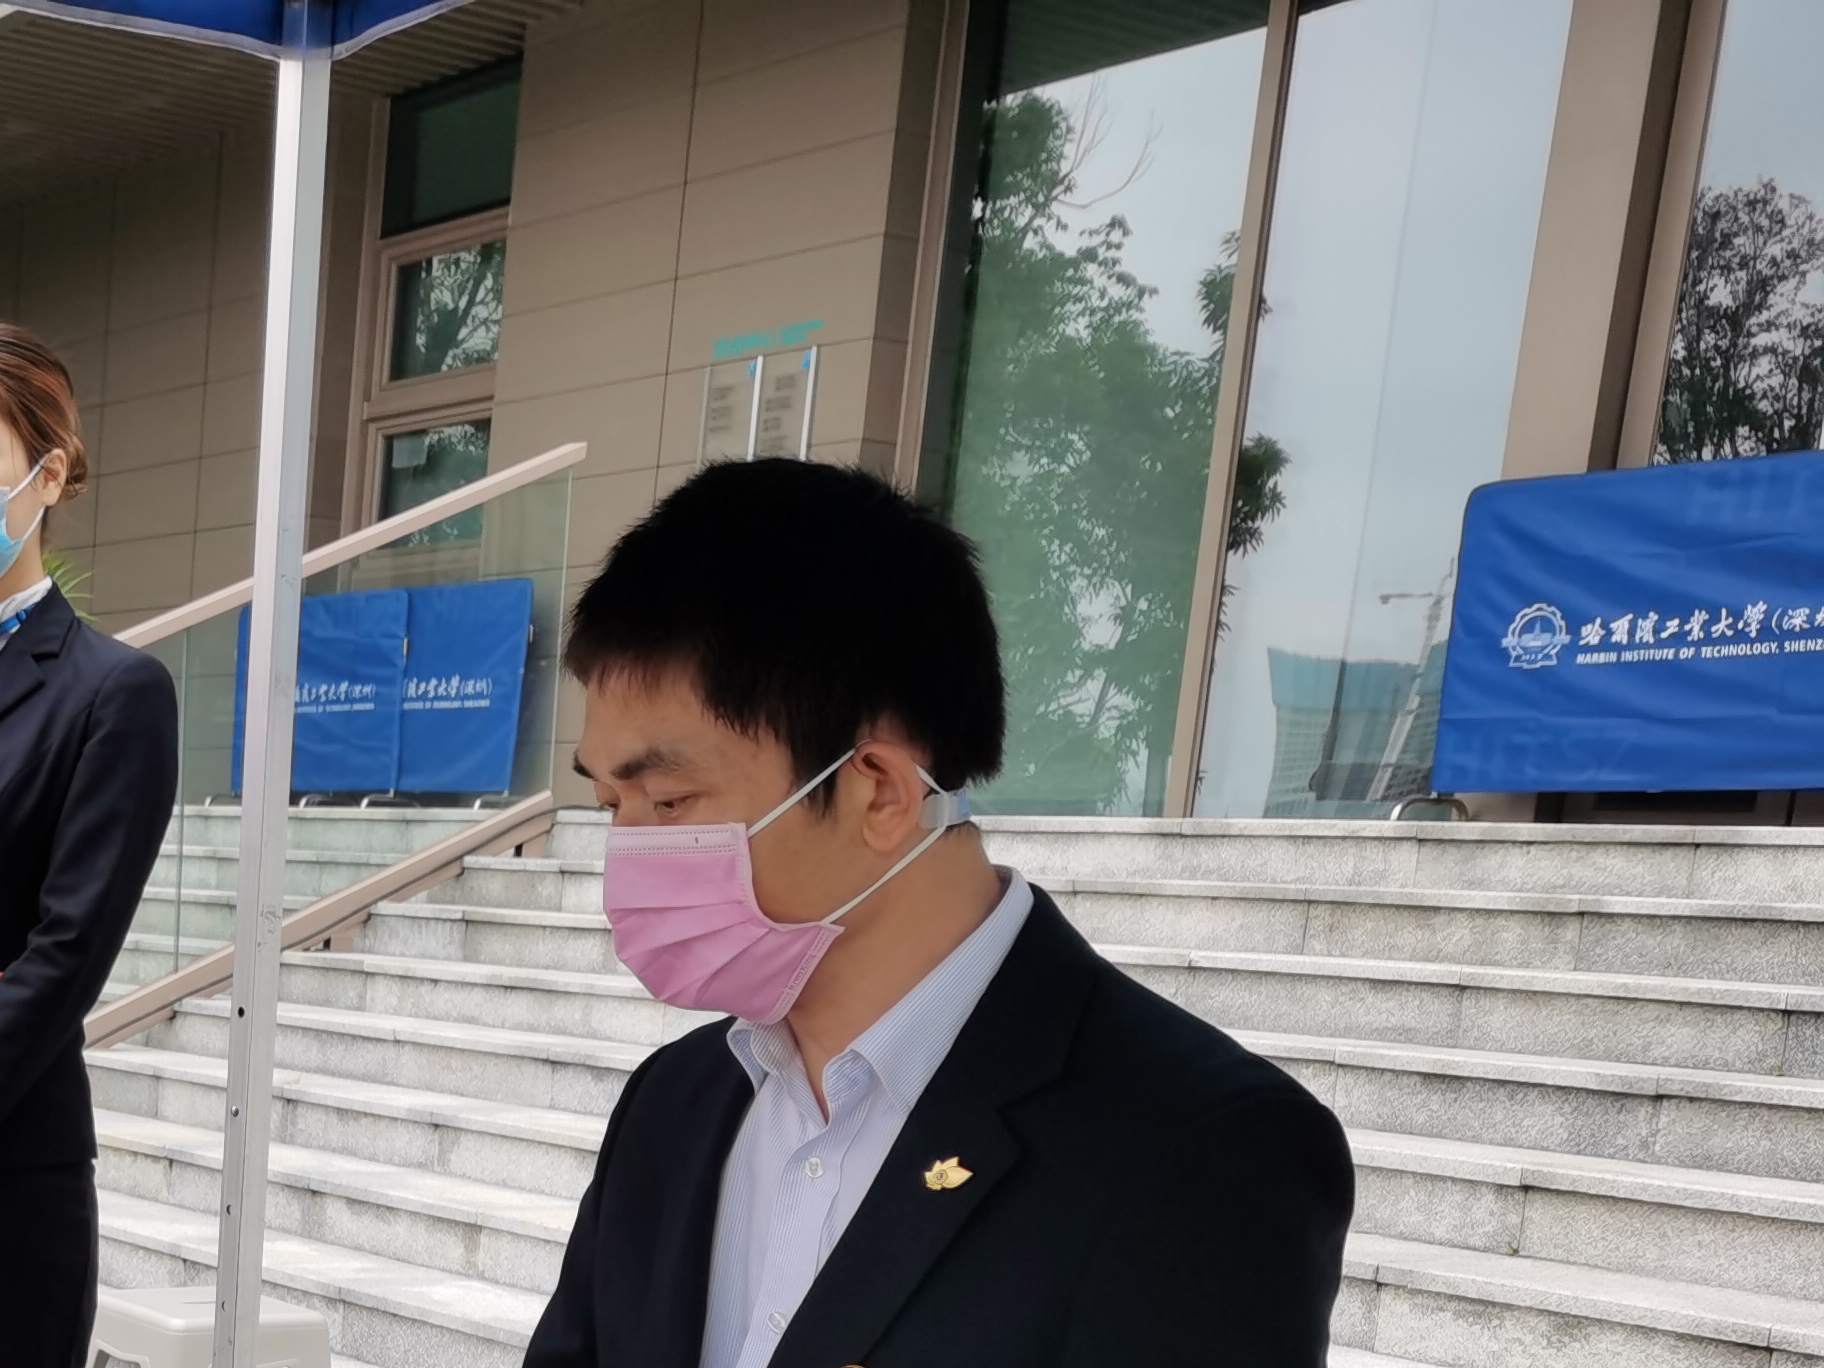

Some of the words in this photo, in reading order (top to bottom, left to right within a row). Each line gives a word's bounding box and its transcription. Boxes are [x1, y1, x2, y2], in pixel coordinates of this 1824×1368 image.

[1576, 653, 1617, 665] HARBIN
[1620, 648, 1675, 663] INSTITUTE
[1679, 647, 1695, 659] OF
